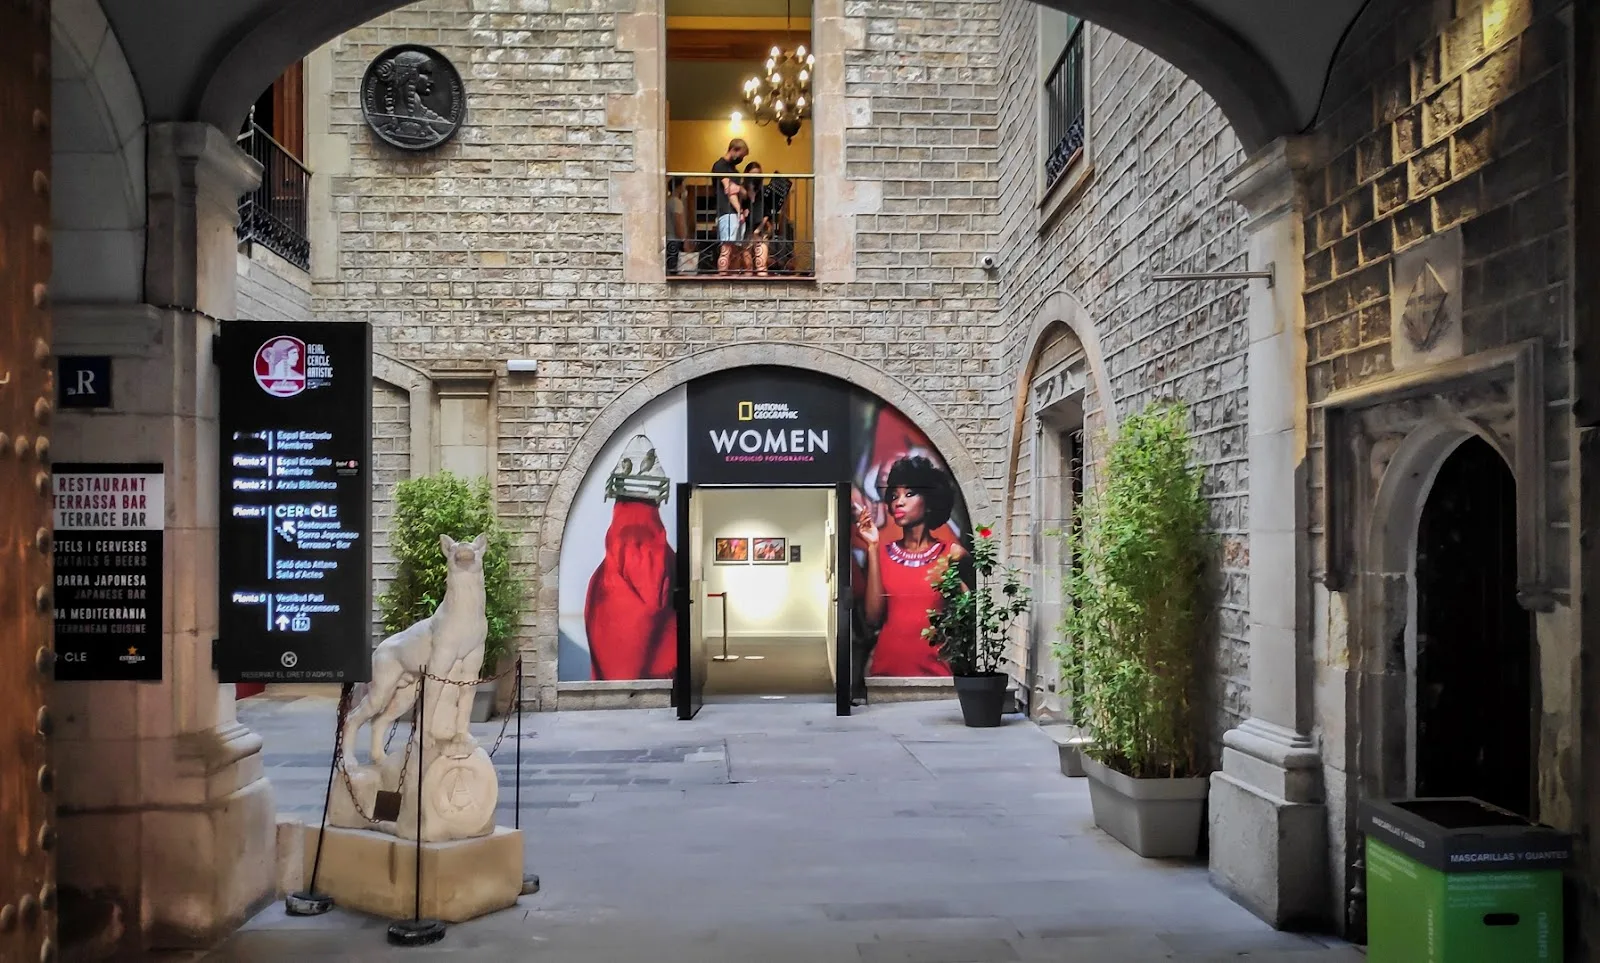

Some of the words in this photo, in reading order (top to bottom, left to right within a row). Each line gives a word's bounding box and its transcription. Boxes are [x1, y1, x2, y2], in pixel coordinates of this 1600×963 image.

[307, 355, 331, 367] CERCLE
[754, 403, 789, 411] NATIONAL
[753, 411, 799, 420] GEOGRAPHIC
[277, 431, 298, 441] Espai
[299, 431, 332, 441] Exclusiu
[709, 429, 829, 453] WOMEN
[277, 441, 313, 450] Membres
[233, 456, 259, 467] Planta
[259, 456, 267, 466] 3
[277, 456, 298, 467] Espai
[299, 456, 332, 466] Exclusiu
[277, 466, 313, 476] Membres
[59, 477, 146, 492] RESTAURANT
[233, 480, 259, 490] Planta
[259, 480, 267, 490] 2
[276, 480, 298, 490] Arxiu
[299, 480, 338, 490] Biblioteca
[53, 495, 117, 509] TERRASSA
[122, 495, 147, 509] BAR
[233, 507, 259, 516] Planta
[260, 505, 266, 515] 1
[60, 512, 117, 527] TERRACE
[122, 512, 147, 527] BAR
[297, 521, 341, 530] Restaurant
[297, 531, 320, 540] Barra
[320, 530, 360, 541] Japonesa
[87, 541, 92, 552] I
[96, 541, 147, 553] CERVESES
[297, 541, 331, 550] Terrassa
[336, 541, 352, 550] Bar
[115, 555, 147, 567] BEERS
[276, 569, 294, 579] Sala
[57, 575, 90, 586] BARRA
[93, 575, 147, 586] JAPONESA
[74, 589, 123, 600] JAPANESE
[127, 589, 147, 599] BAR
[233, 593, 259, 603] Planta
[70, 605, 147, 620] MEDITERRÀNIA
[299, 603, 341, 613] Ascensors
[110, 624, 147, 634] CUISINE
[241, 671, 275, 679] RESERVAT
[1372, 816, 1401, 837] MASCARILLAS
[1403, 831, 1426, 849] GUANTES
[1450, 852, 1515, 863] MASCARILLAS
[1517, 852, 1524, 861] Y
[1525, 850, 1569, 861] GUANTES
